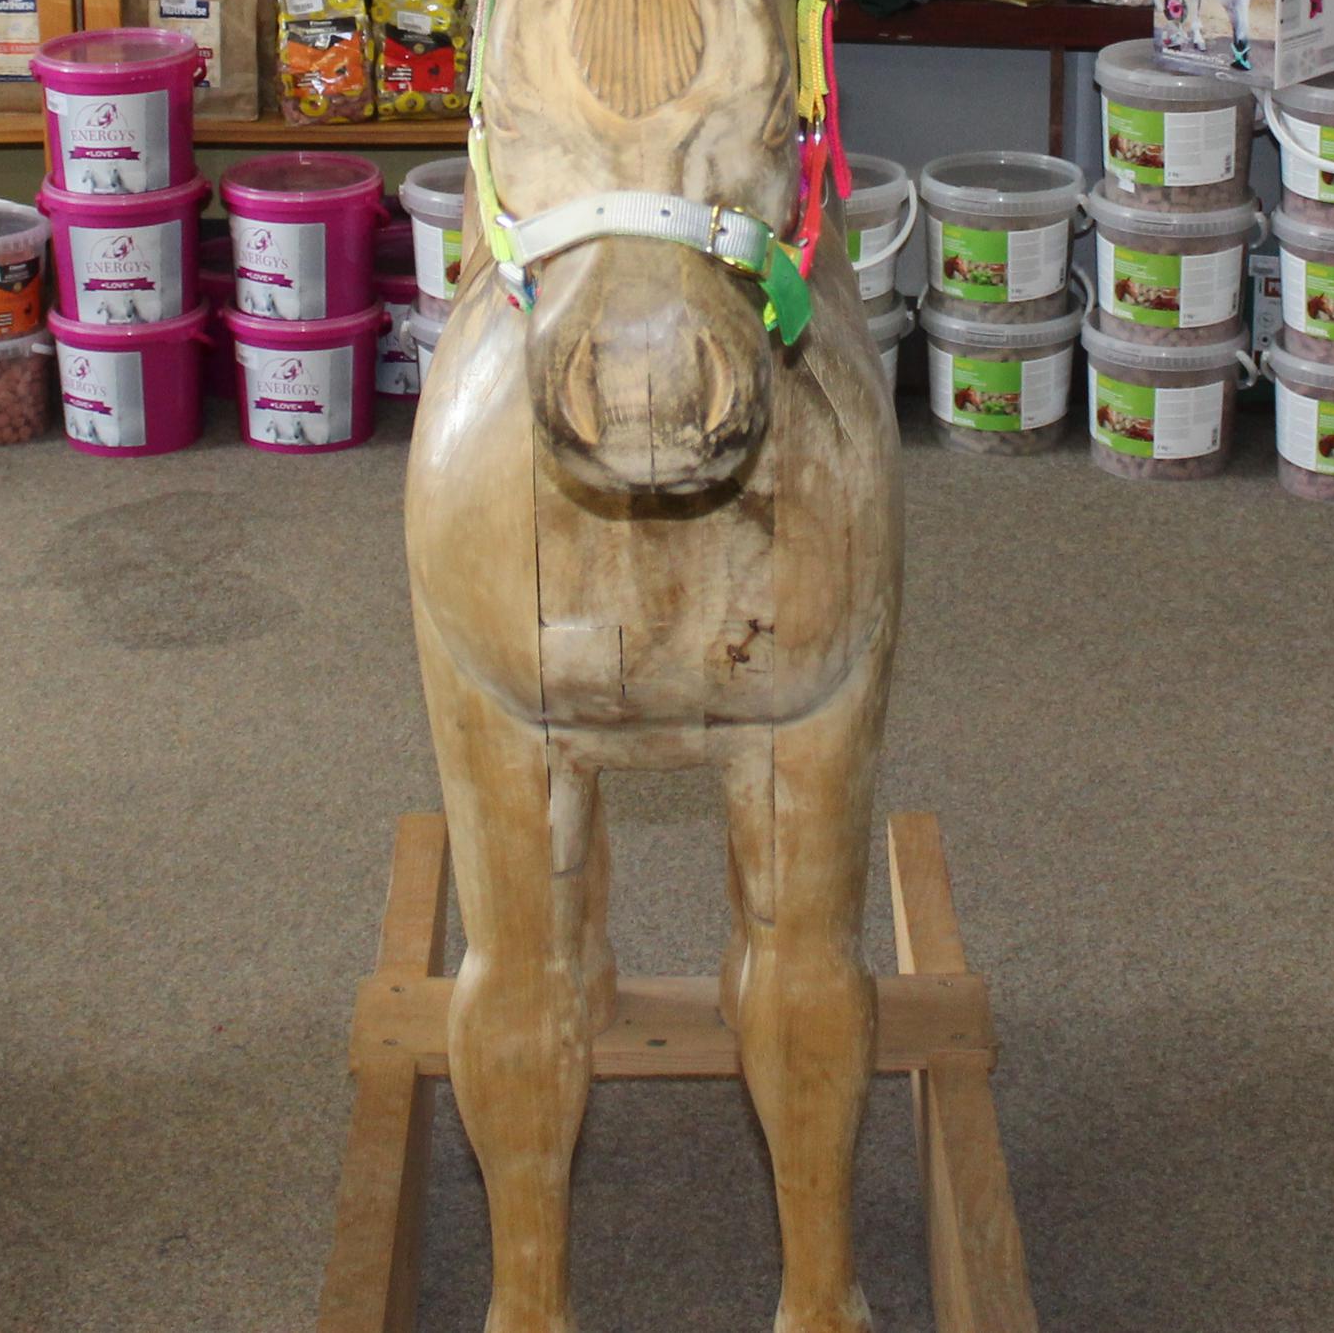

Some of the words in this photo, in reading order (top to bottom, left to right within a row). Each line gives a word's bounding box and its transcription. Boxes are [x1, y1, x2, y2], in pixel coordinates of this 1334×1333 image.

[70, 129, 136, 143] ENERGYS
[89, 150, 114, 158] LOVE
[84, 259, 152, 275] ENERGYS
[104, 281, 130, 290] LOVE
[255, 379, 321, 397] ENERGYS
[274, 402, 300, 411] LOVE
